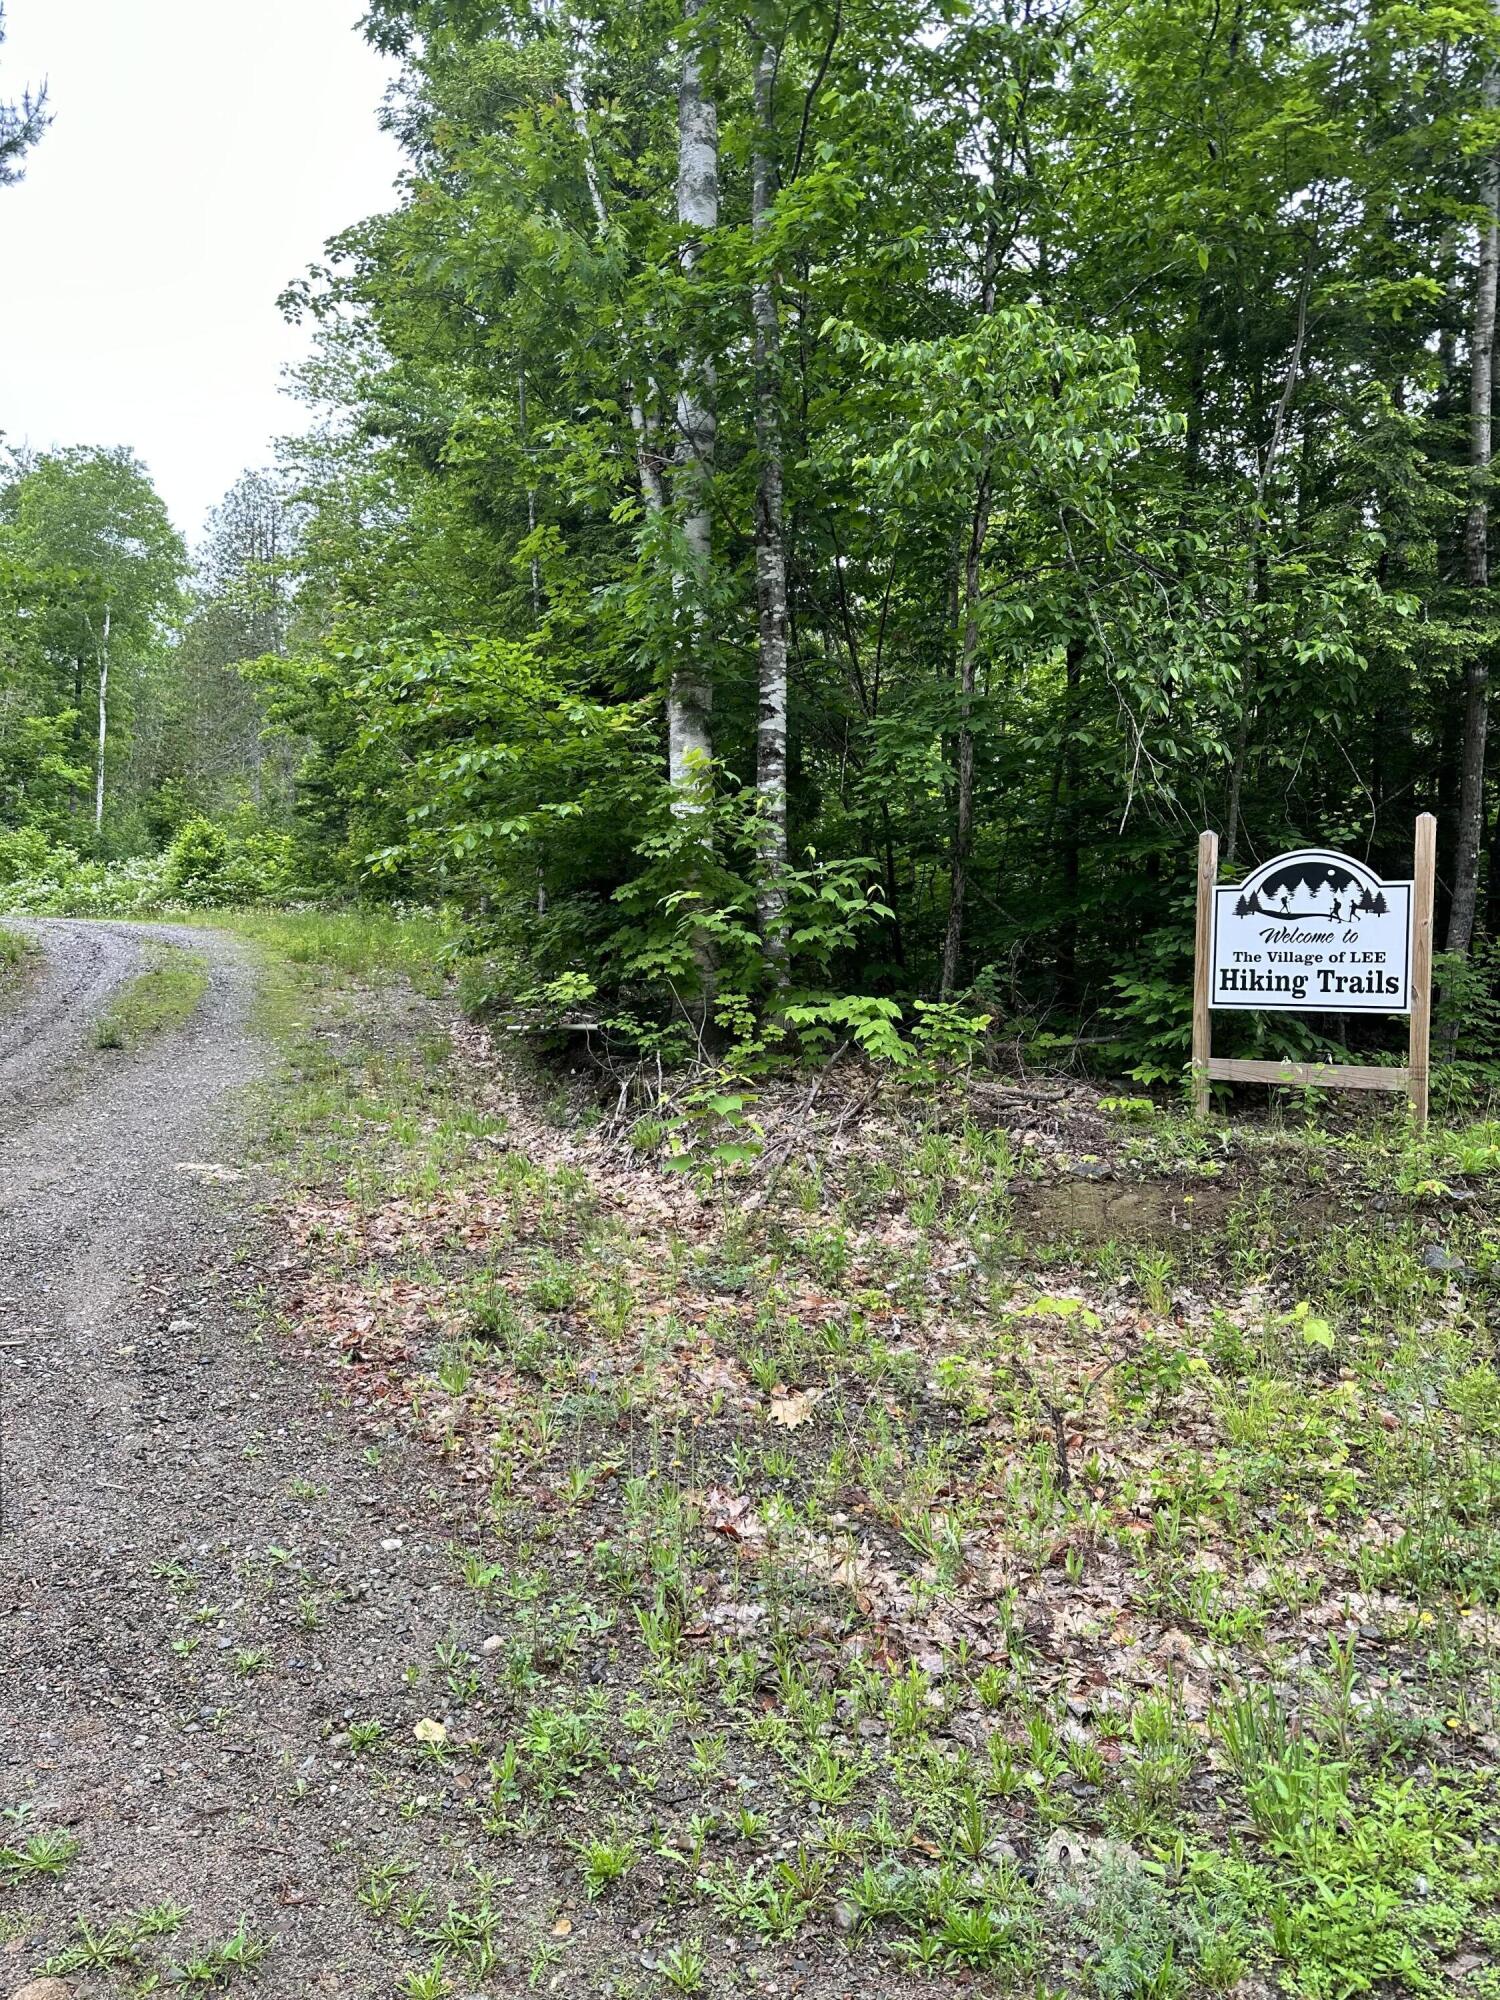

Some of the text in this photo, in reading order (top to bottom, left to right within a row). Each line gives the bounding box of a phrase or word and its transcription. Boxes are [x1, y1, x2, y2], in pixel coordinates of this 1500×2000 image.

[1258, 926, 1359, 944] Welcome to
[1232, 951, 1387, 966] The Village of LEE
[1219, 968, 1400, 999] Hiking Trails
